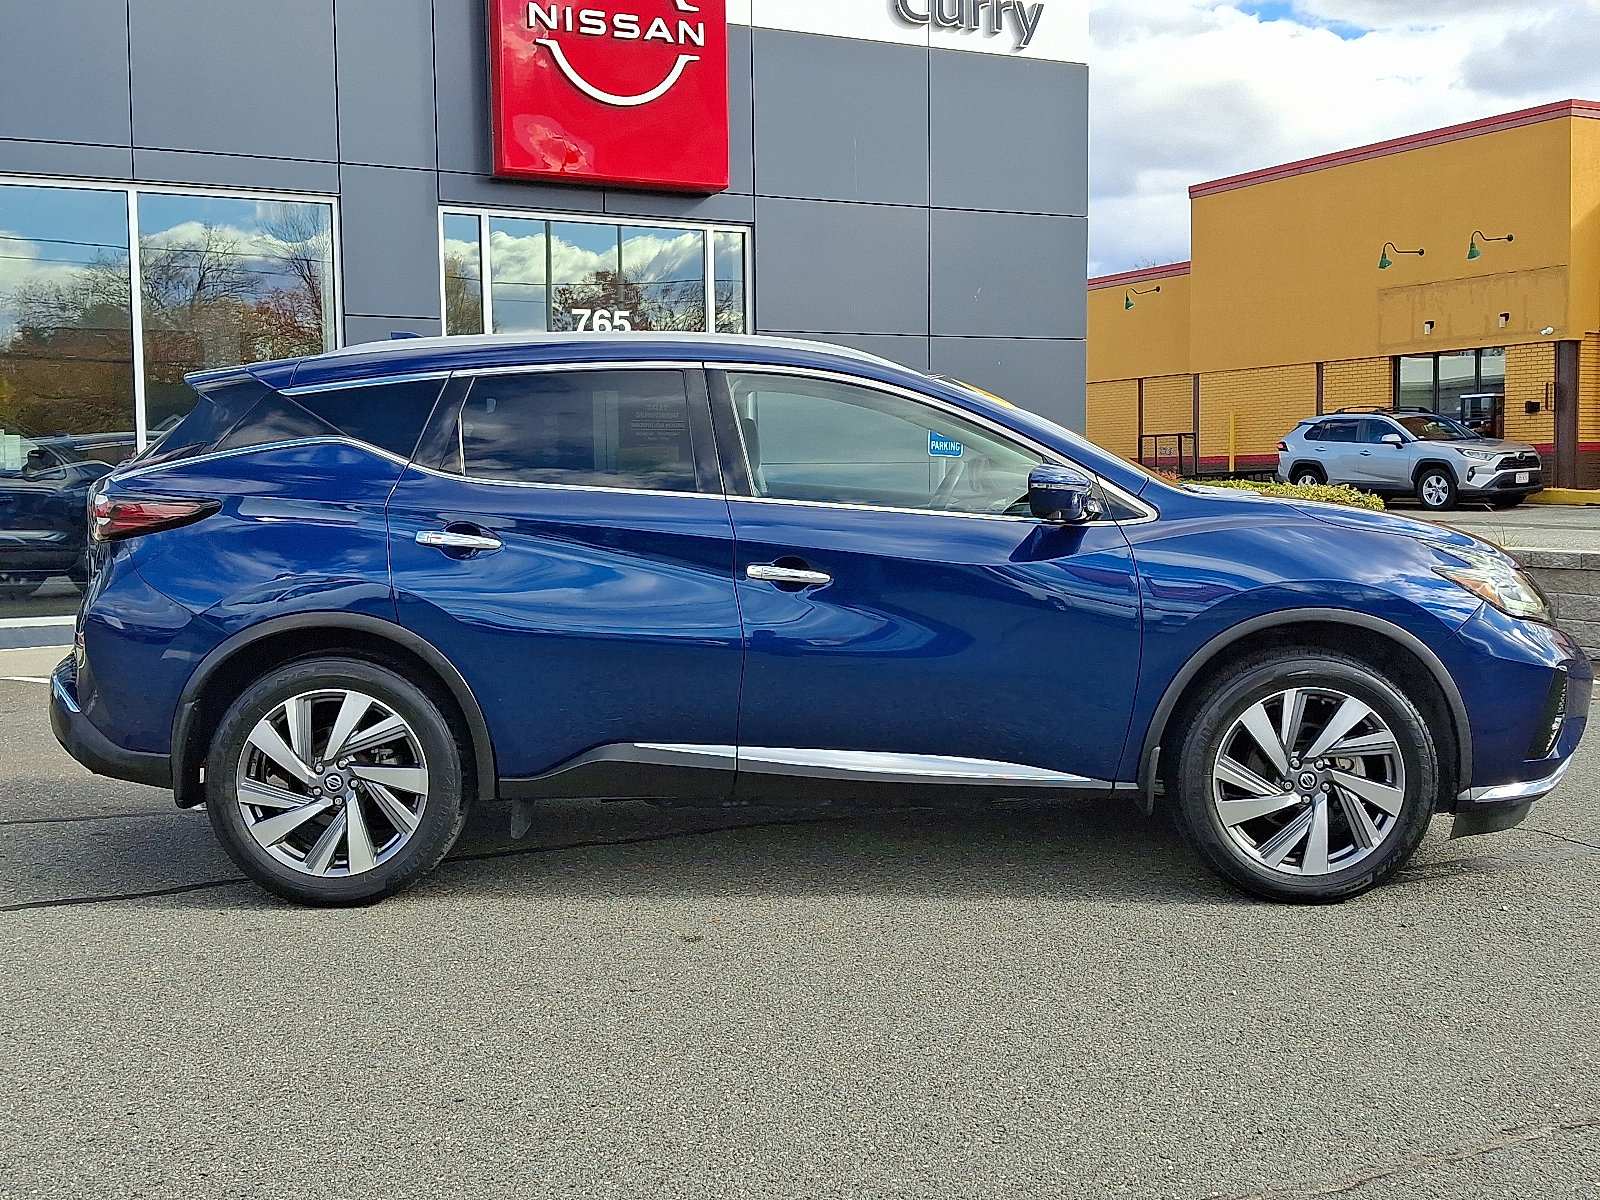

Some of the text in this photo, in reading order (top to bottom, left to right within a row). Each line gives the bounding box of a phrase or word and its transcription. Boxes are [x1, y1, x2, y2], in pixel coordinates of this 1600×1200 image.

[527, 1, 705, 47] NISSAN
[894, 0, 1045, 47] Curry
[571, 308, 632, 332] 765
[930, 440, 961, 452] PARKING
